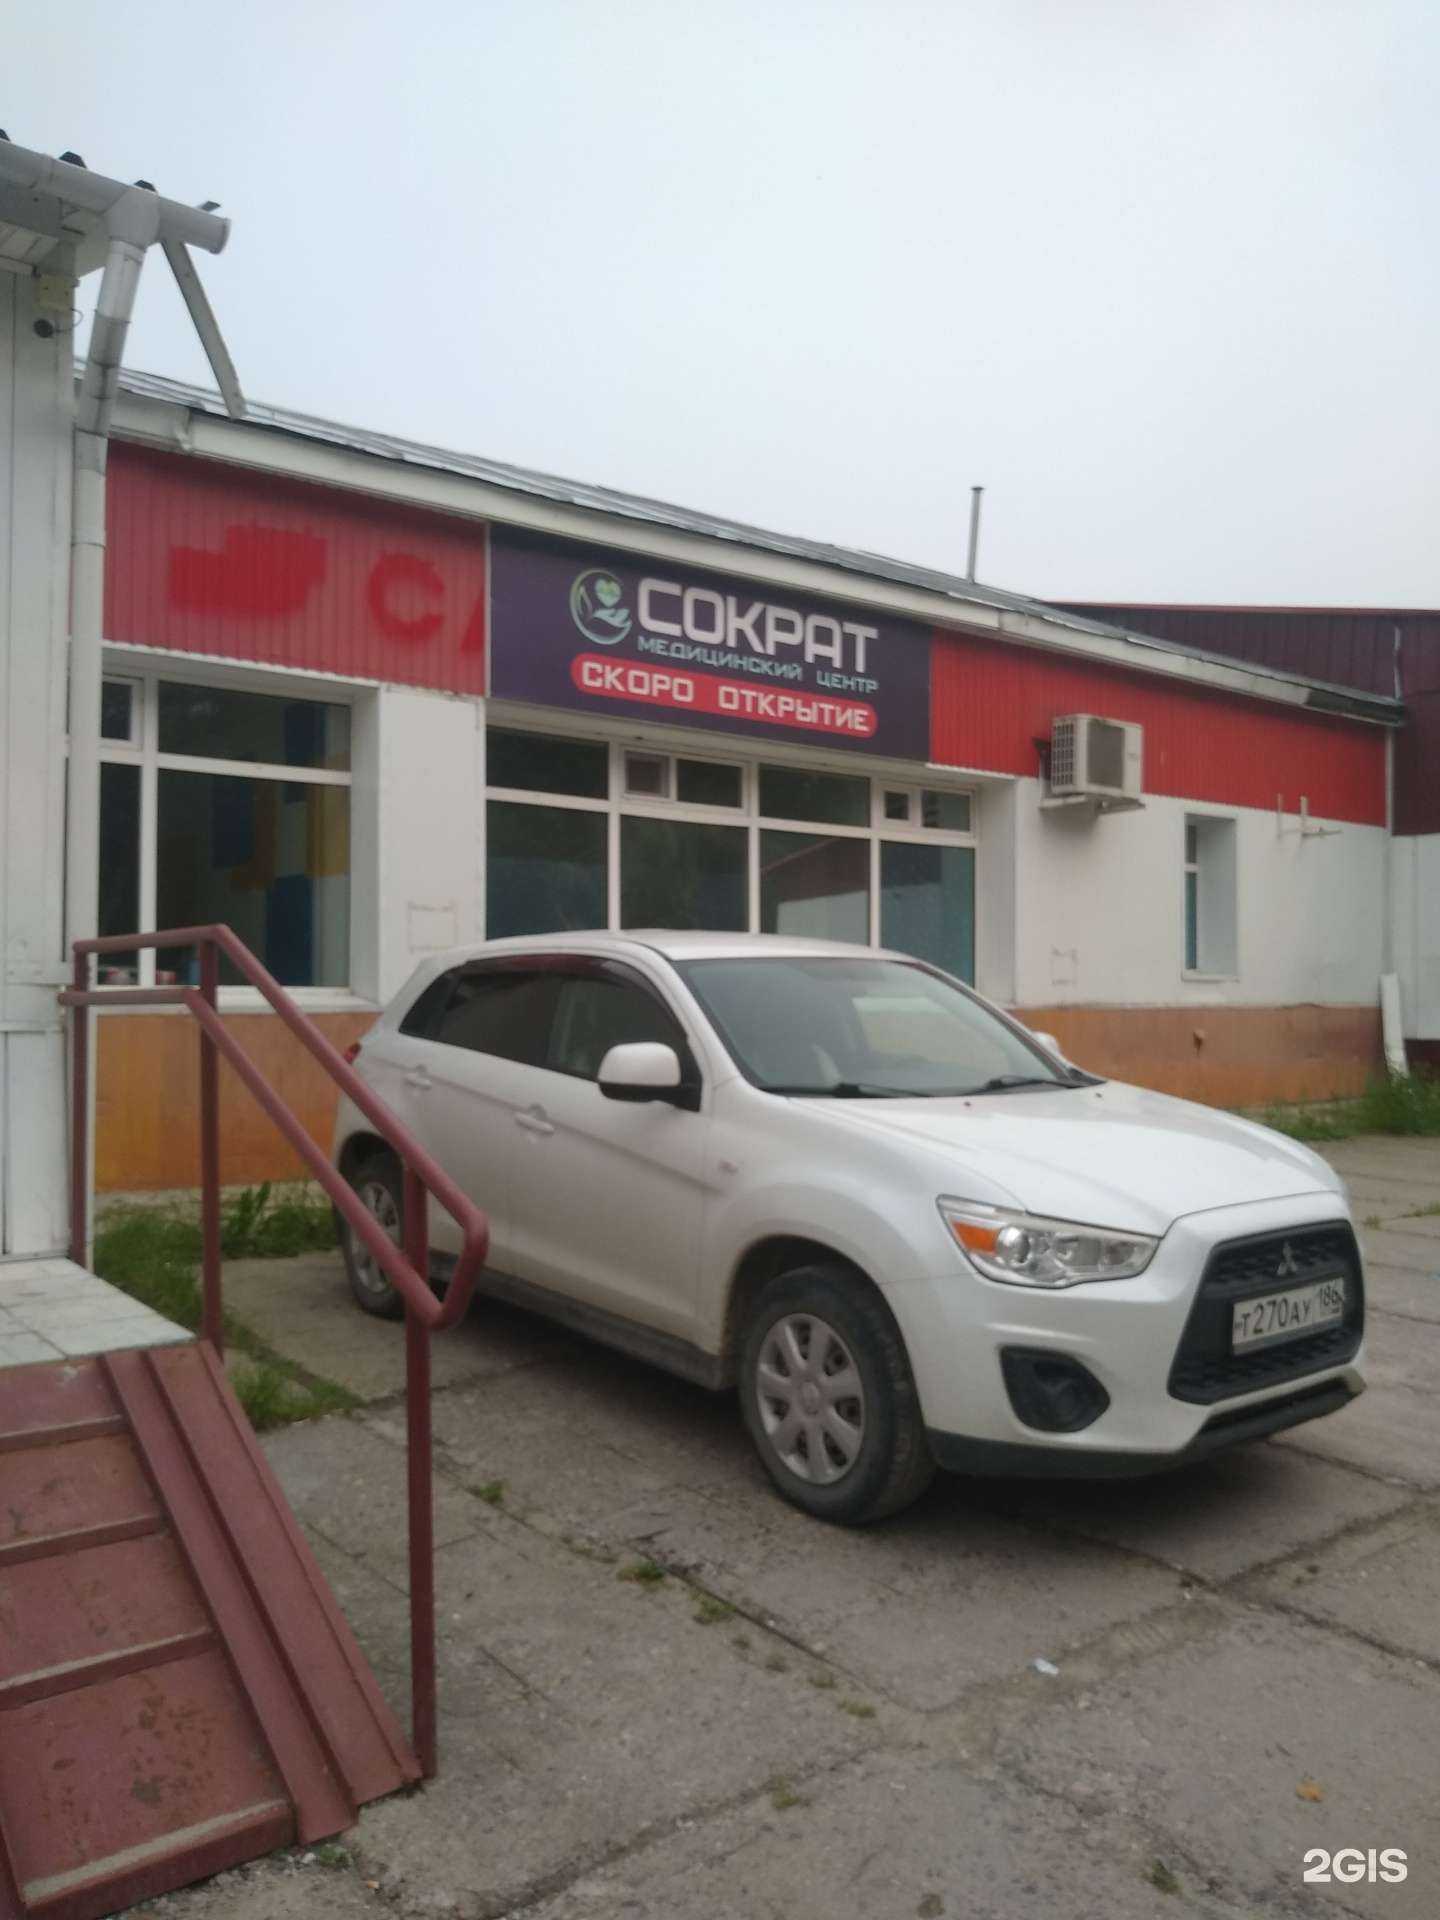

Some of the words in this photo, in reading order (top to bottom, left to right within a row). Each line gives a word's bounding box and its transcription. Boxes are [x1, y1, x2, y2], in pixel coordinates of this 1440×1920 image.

[637, 577, 879, 674] СОКРАТ
[581, 660, 694, 703] СКОРО
[717, 685, 870, 732] ОТКРЫТИЕ
[637, 636, 803, 680] МЕДИЦИНСКИЙ
[815, 670, 879, 694] ЦЕНТР
